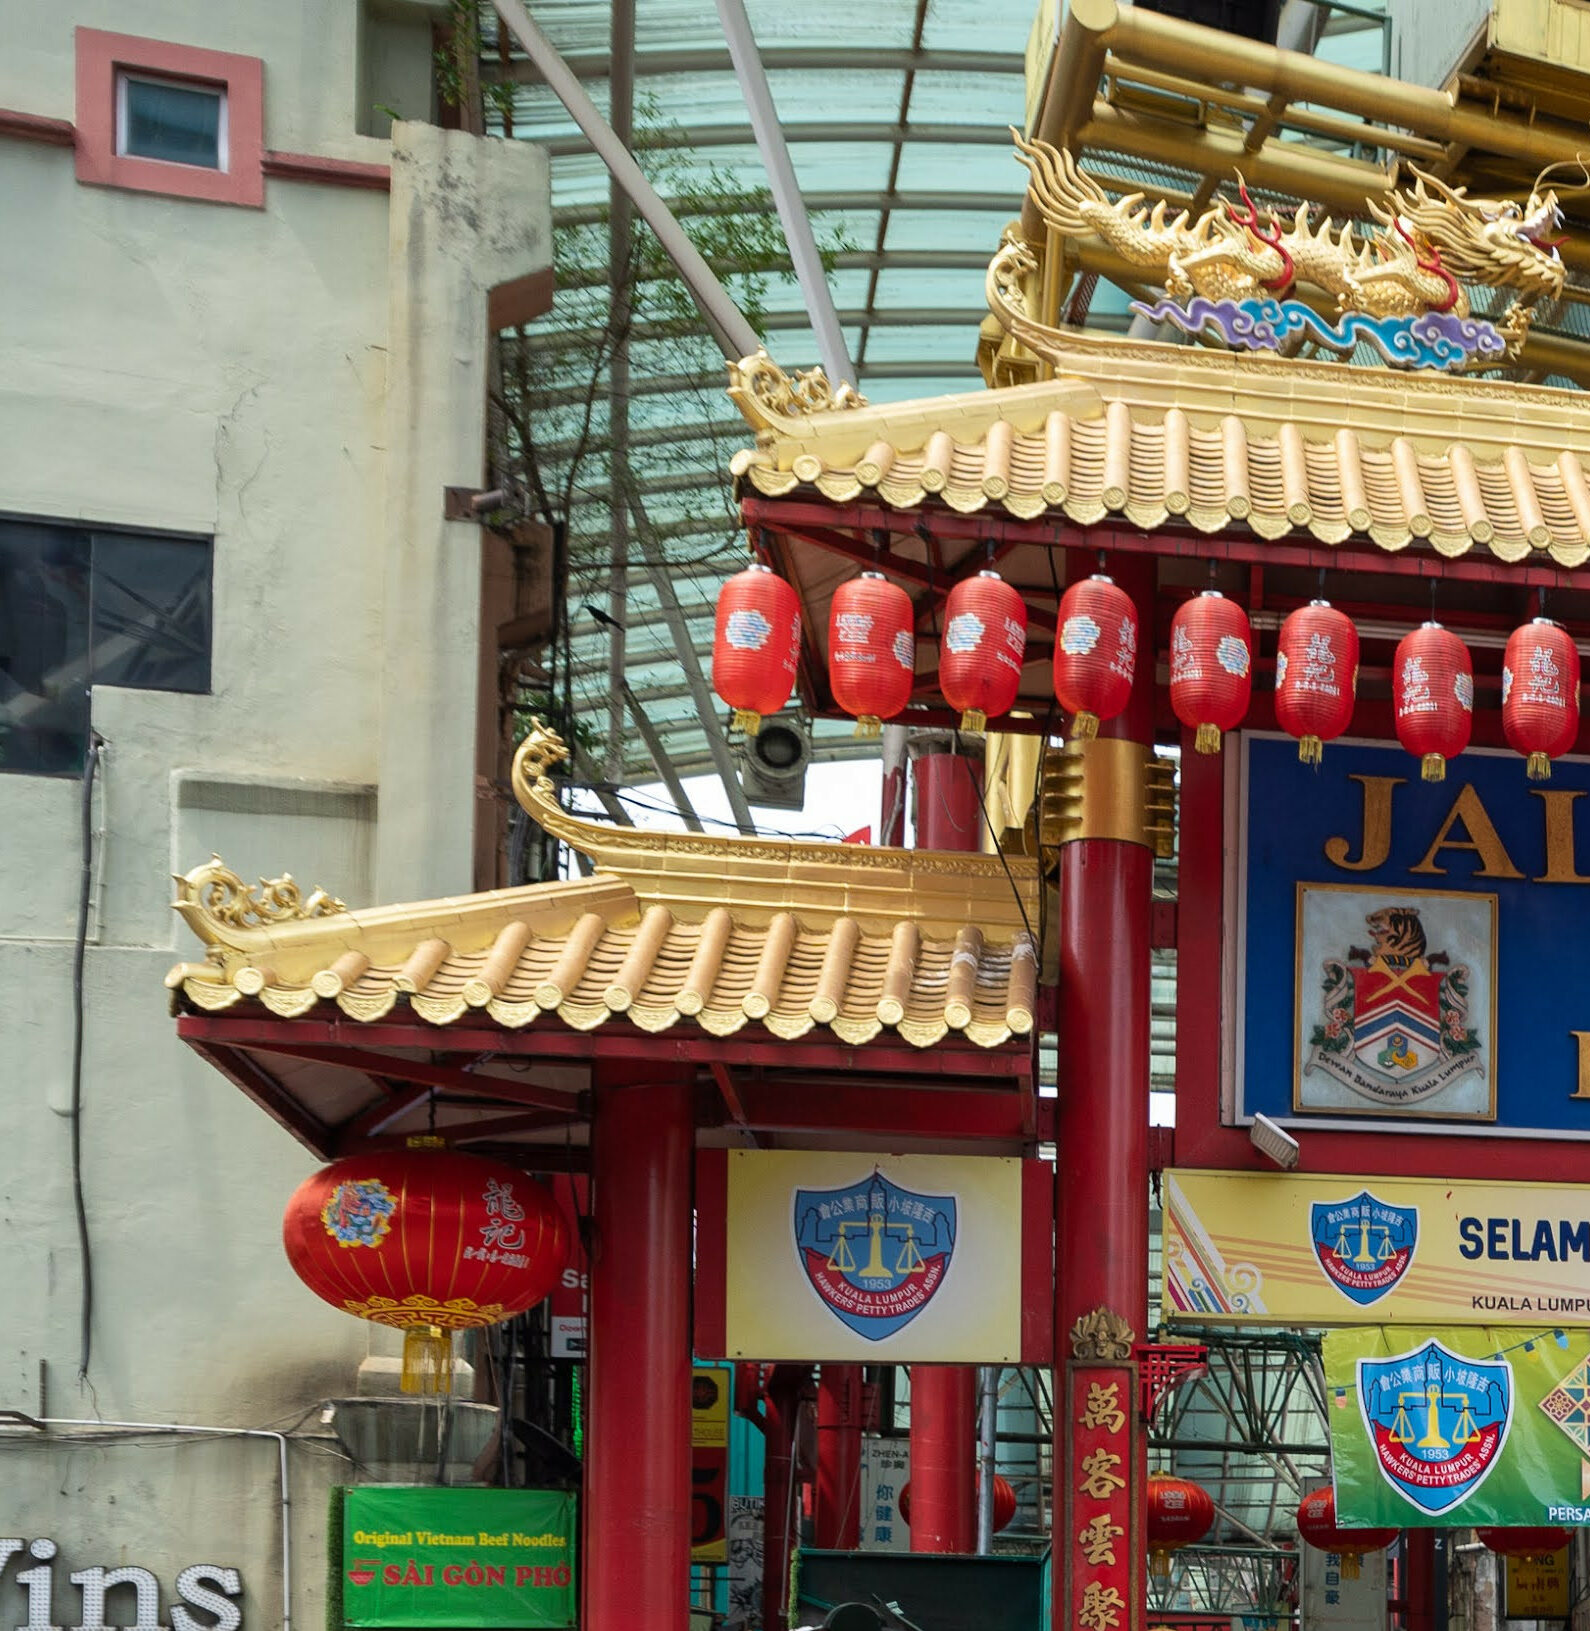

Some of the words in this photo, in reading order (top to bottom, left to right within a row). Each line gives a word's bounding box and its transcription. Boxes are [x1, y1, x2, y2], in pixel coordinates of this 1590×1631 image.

[1318, 1051, 1352, 1078] Dewan
[1411, 1079, 1438, 1097] Kuala
[1439, 1054, 1476, 1081] Lumpur
[838, 1281, 872, 1305] KUALA
[875, 1282, 917, 1305] LUMPUR
[862, 1279, 891, 1290] 1953
[856, 1302, 887, 1315] PETTY
[1471, 1295, 1534, 1313] KUALA
[1400, 1452, 1431, 1474] KUALA
[1434, 1453, 1475, 1474] LUMPUR
[1422, 1449, 1449, 1460] 1953
[1416, 1473, 1447, 1486] PETTY
[354, 1530, 413, 1548] Original
[416, 1530, 475, 1548] Vietnam
[478, 1530, 509, 1548] Beef
